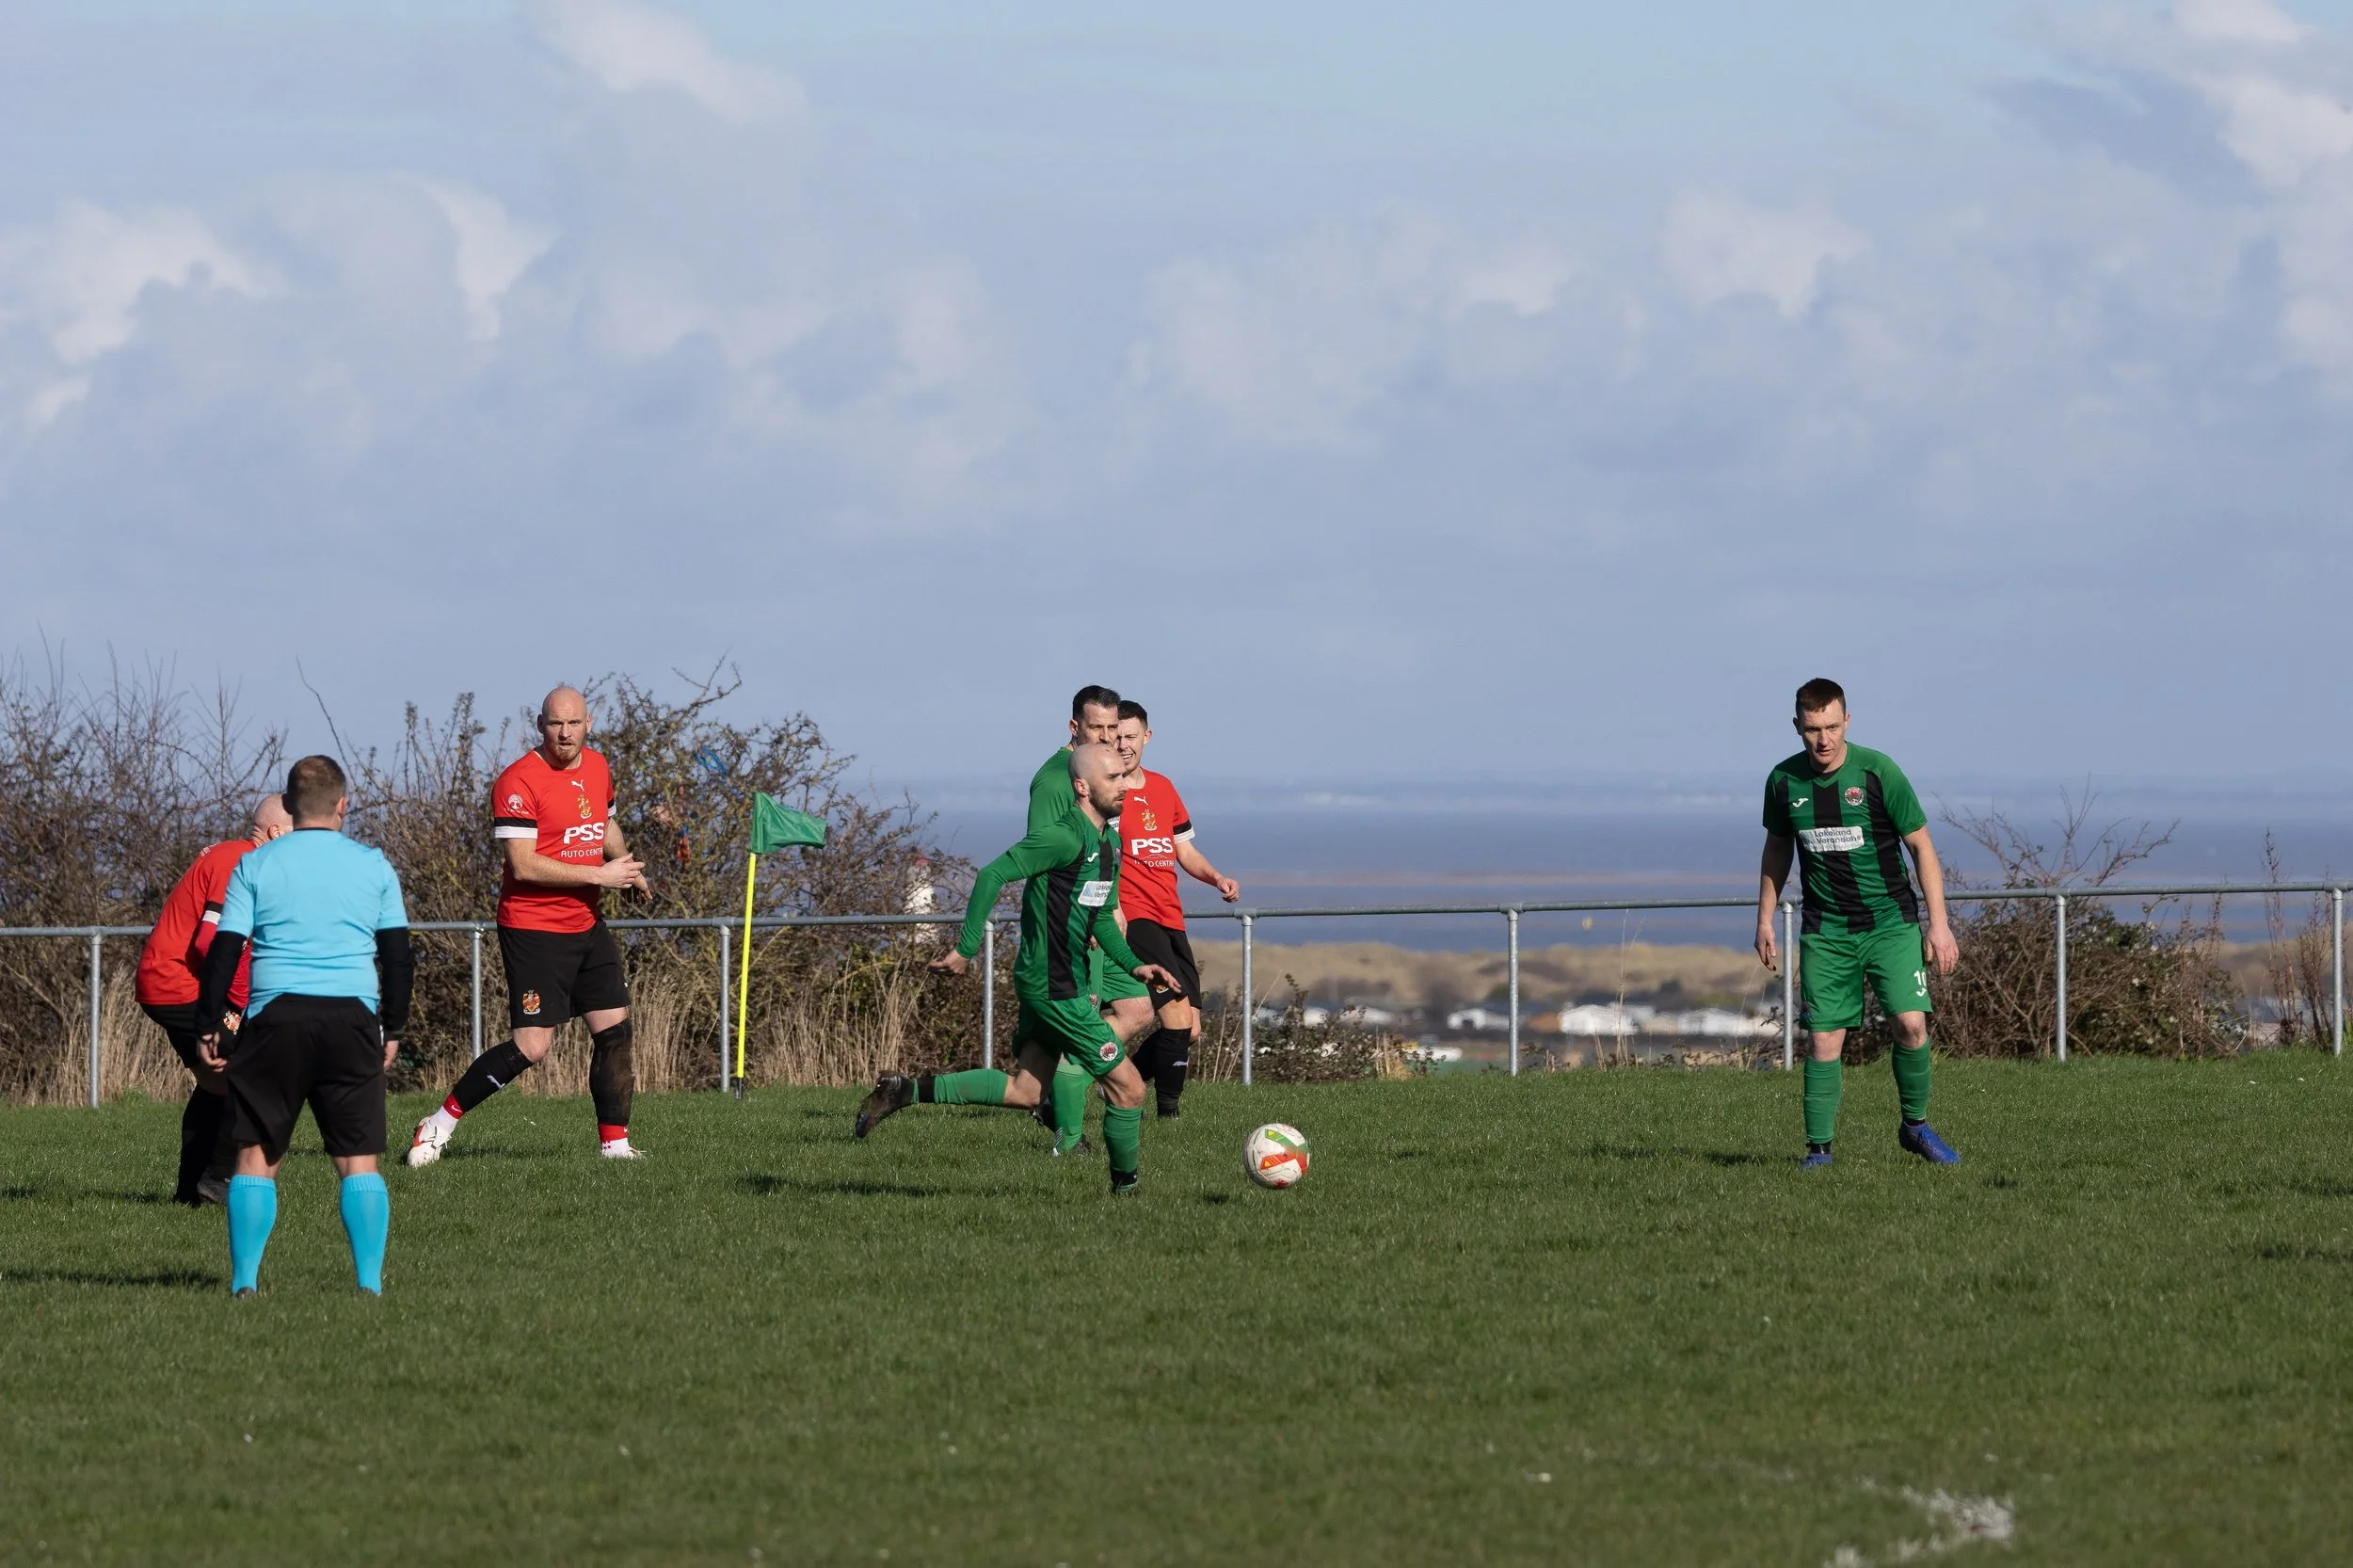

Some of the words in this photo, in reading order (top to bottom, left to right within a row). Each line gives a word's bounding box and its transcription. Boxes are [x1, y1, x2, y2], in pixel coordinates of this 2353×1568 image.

[563, 822, 604, 844] PSS
[1815, 829, 1851, 838] Lakeland
[1817, 836, 1861, 844] Verandahs
[1131, 838, 1174, 856] PSS
